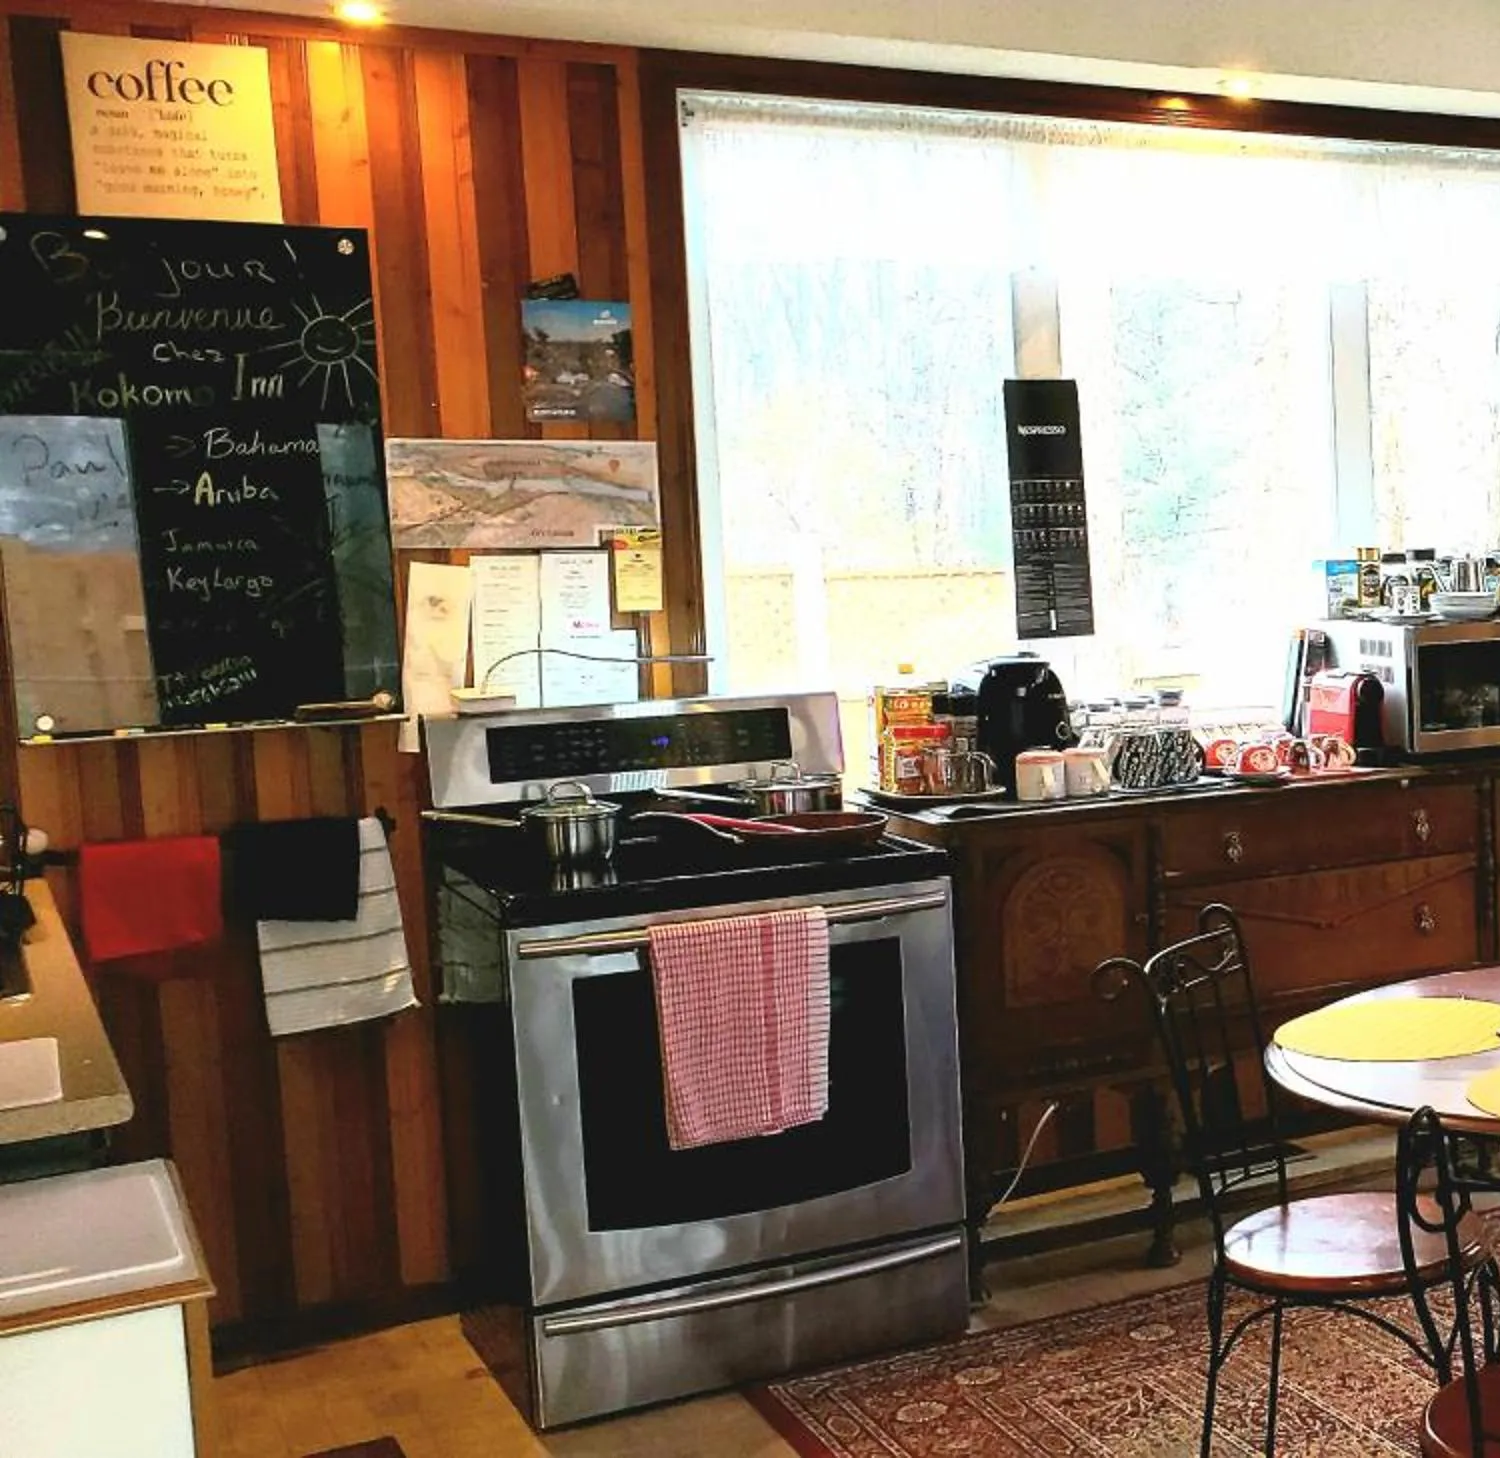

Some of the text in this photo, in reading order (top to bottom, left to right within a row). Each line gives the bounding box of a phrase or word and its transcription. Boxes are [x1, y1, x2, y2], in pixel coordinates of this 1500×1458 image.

[87, 59, 234, 107] coffee
[232, 353, 285, 401] Inn
[194, 470, 281, 509] Aruba
